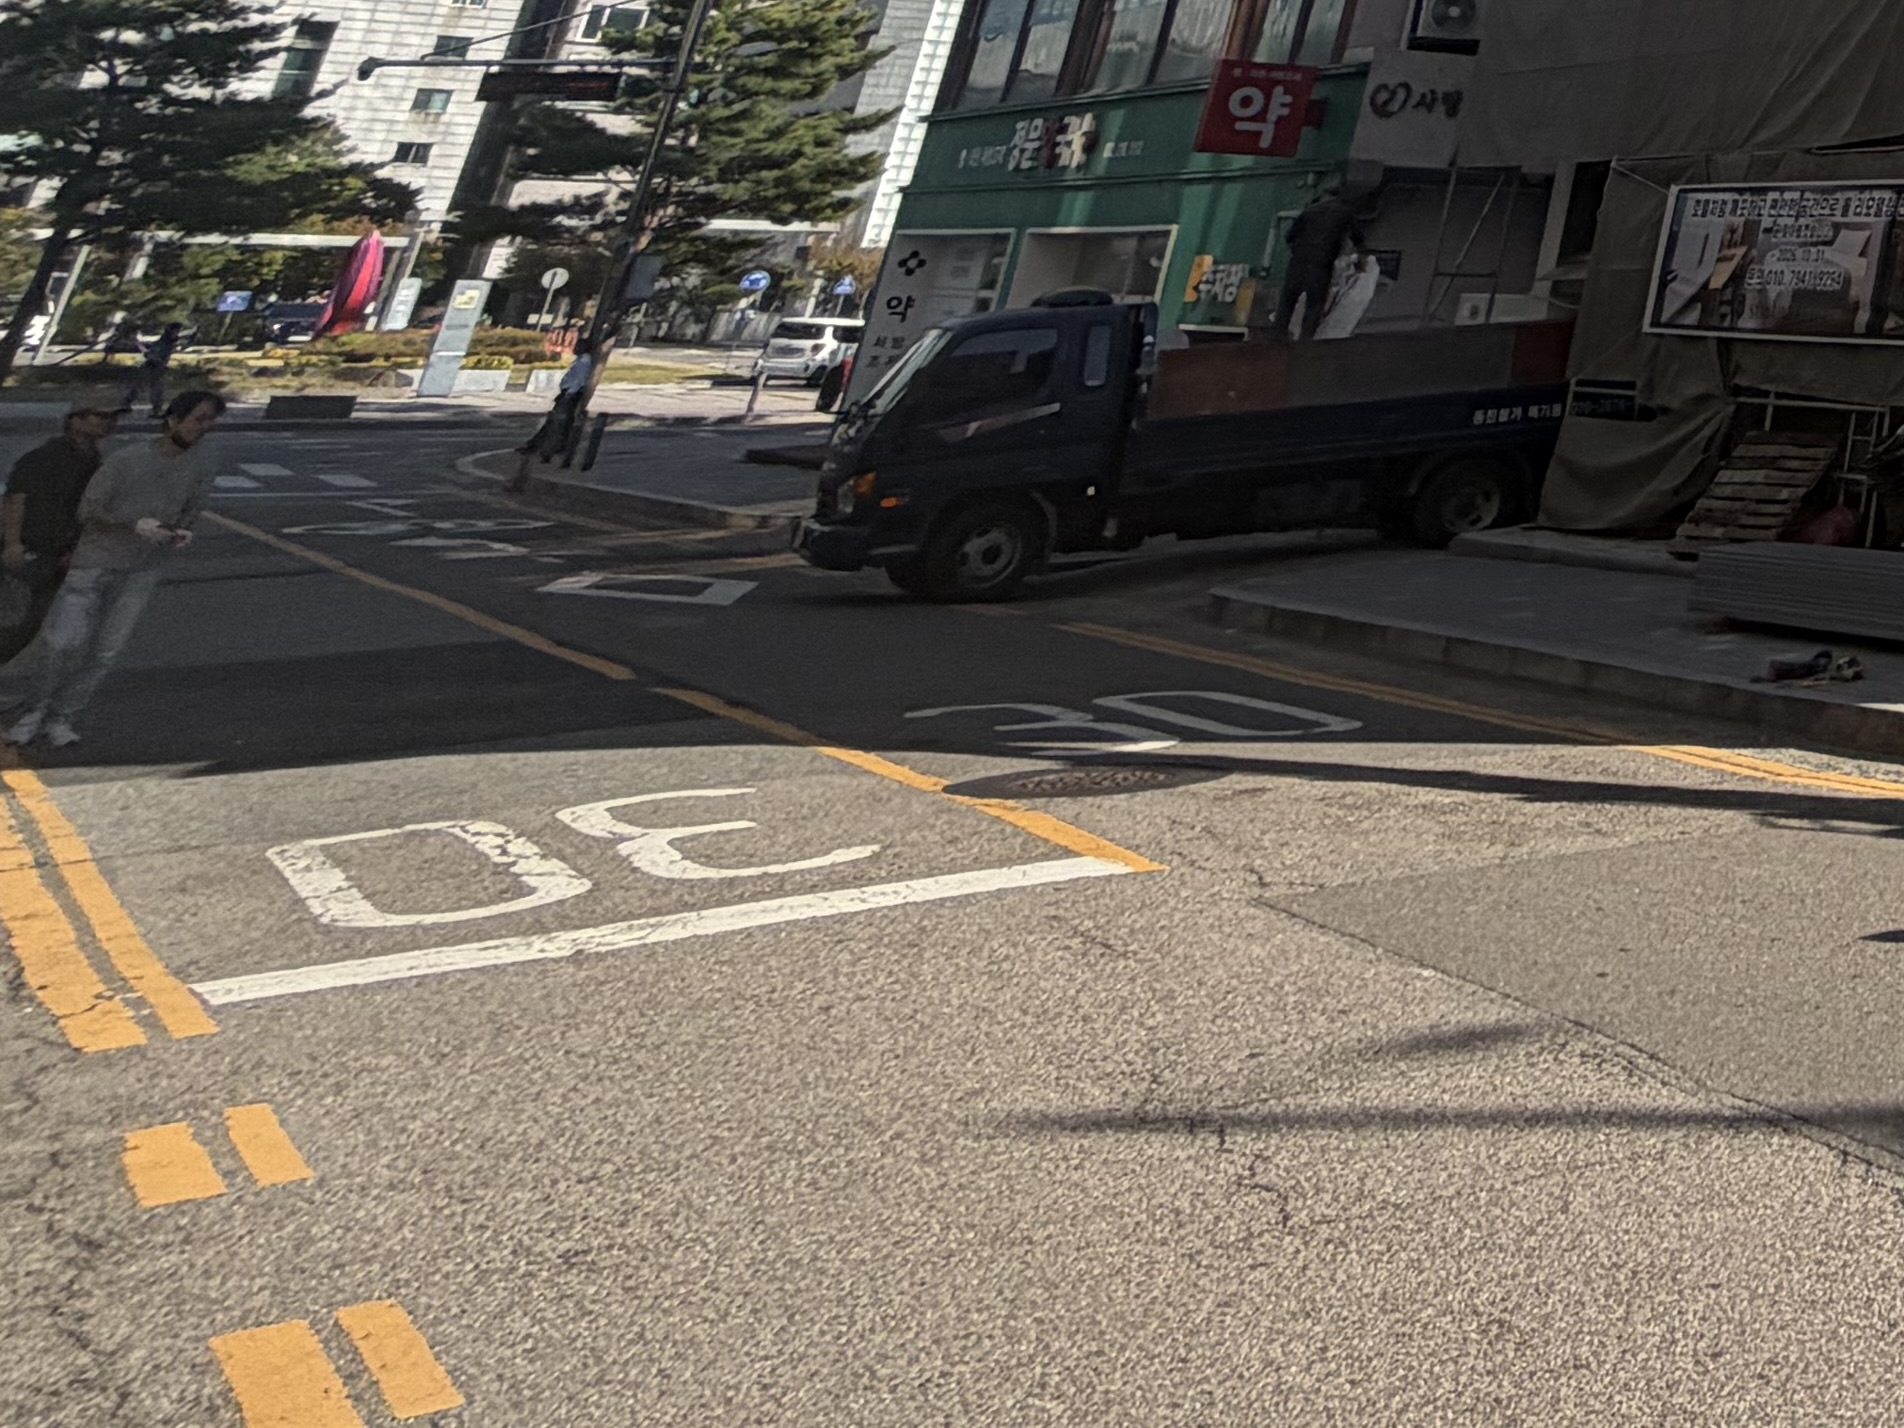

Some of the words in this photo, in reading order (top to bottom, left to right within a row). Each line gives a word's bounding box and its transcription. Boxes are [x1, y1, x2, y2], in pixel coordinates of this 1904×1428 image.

[1228, 85, 1294, 150] 약
[885, 294, 916, 323] 약
[902, 690, 1363, 756] 30
[267, 787, 881, 929] 30
